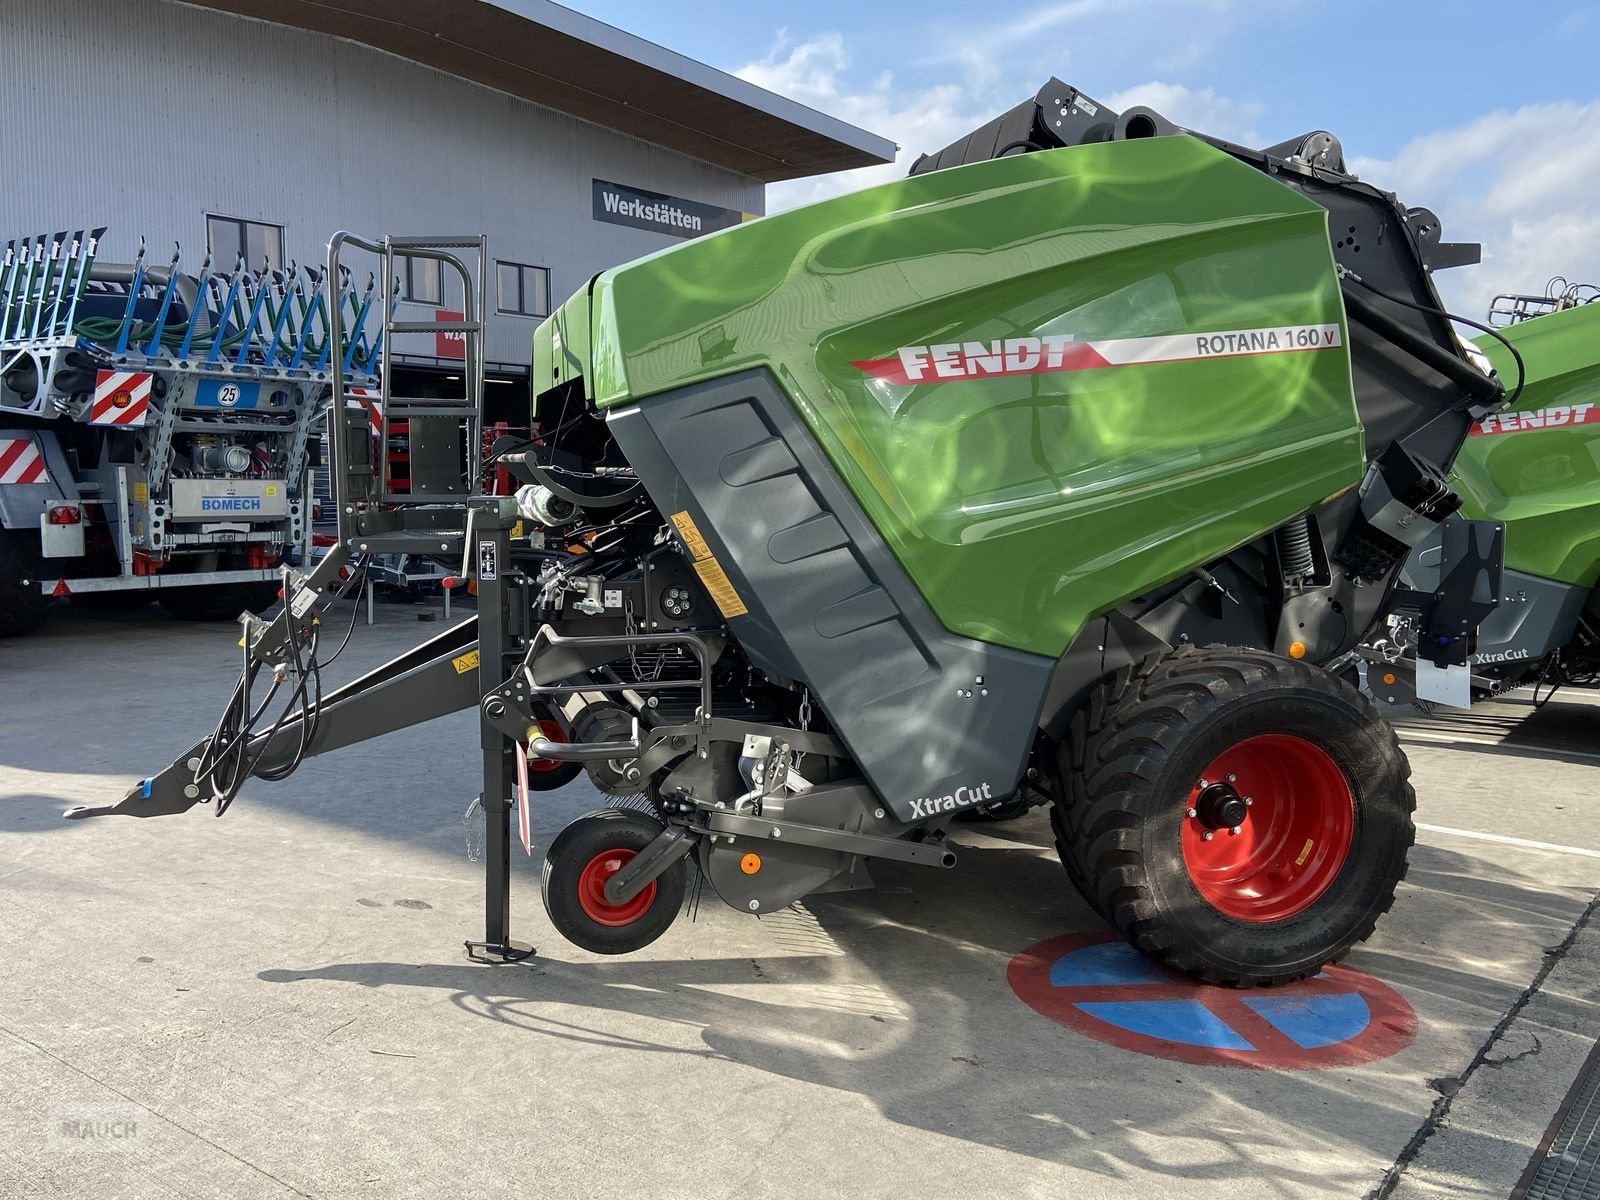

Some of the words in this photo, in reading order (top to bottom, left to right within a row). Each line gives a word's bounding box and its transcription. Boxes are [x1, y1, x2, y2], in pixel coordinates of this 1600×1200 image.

[602, 191, 702, 231] Werkstätten
[1196, 331, 1280, 355] ROTANA
[1285, 328, 1320, 348] 160
[897, 334, 1074, 380] FENDT
[221, 387, 237, 402] 25
[1480, 403, 1595, 434] FENDT
[201, 499, 261, 511] BOMECH
[1475, 648, 1529, 664] XtraCut
[908, 782, 992, 820] XtraCut
